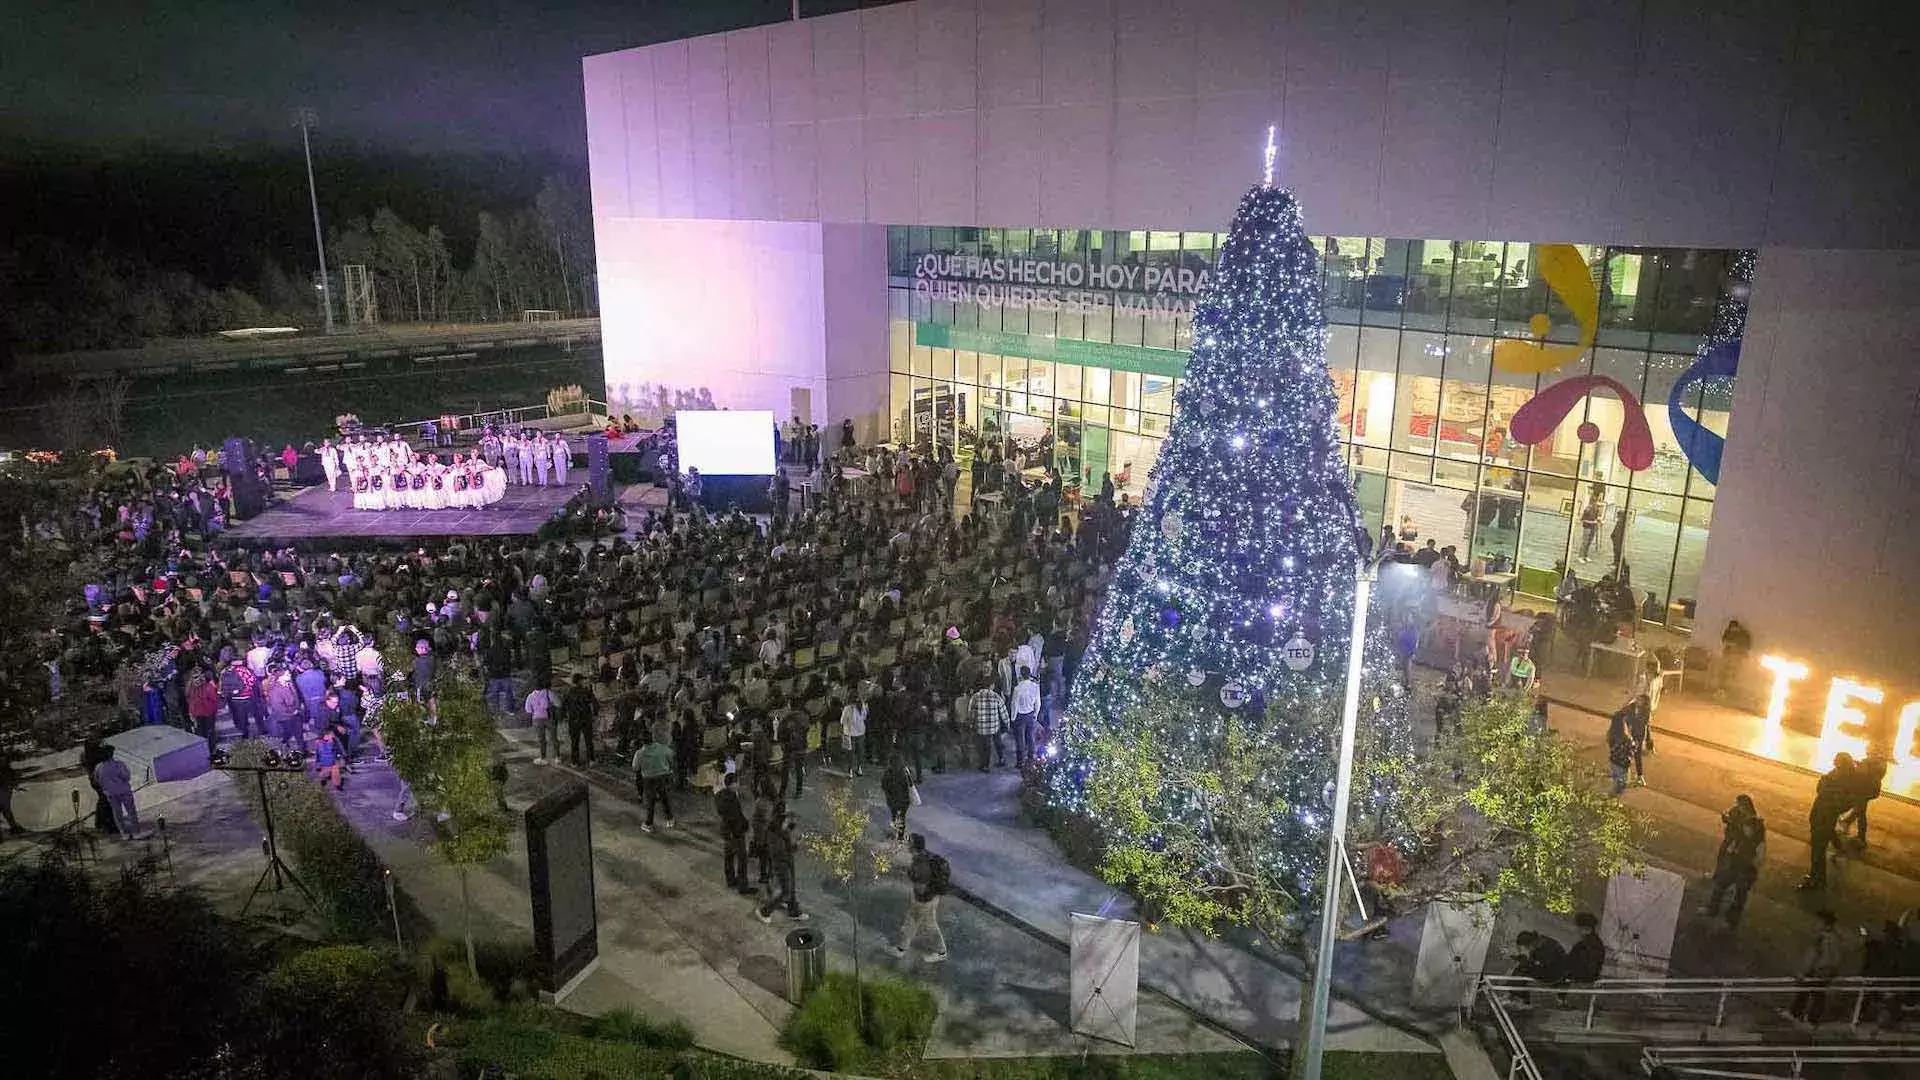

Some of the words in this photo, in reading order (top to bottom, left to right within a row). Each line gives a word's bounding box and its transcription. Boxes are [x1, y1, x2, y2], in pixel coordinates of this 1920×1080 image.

[915, 249, 963, 279] ¿QUÉ
[965, 256, 1006, 281] HAS
[1008, 259, 1084, 287] HECHO
[1088, 261, 1140, 290] HOY
[1144, 266, 1209, 294] PARA
[915, 279, 972, 304] QUIEN
[976, 283, 1061, 311] QUIERES
[1066, 291, 1109, 315] SER
[1287, 648, 1310, 659] TEC
